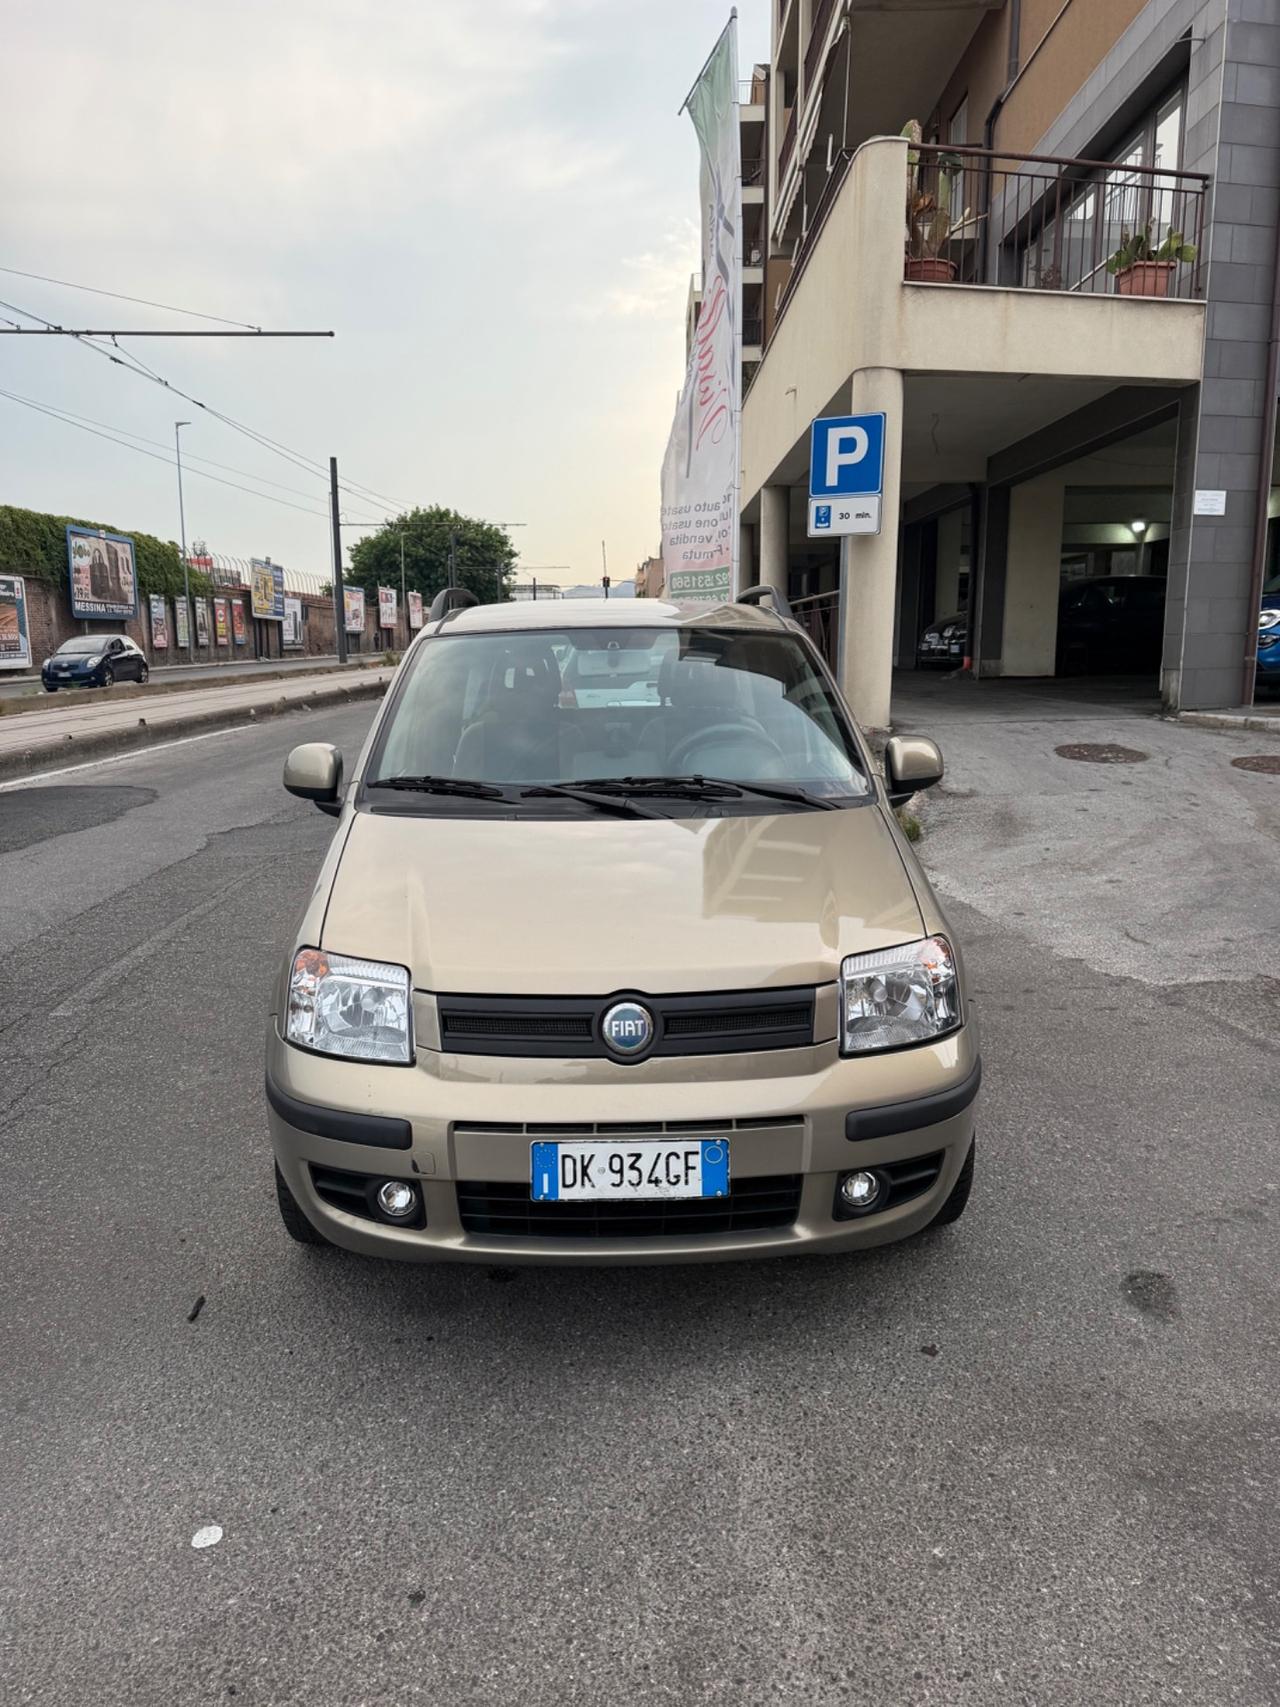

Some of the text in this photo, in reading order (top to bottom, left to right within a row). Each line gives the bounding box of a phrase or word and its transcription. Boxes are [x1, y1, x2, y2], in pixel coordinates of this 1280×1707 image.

[825, 425, 869, 487] P
[839, 510, 872, 520] 30 min.
[74, 601, 106, 613] MESSINA
[611, 1019, 644, 1037] FIAT
[561, 1153, 596, 1189] DK
[608, 1150, 699, 1189] 934GF
